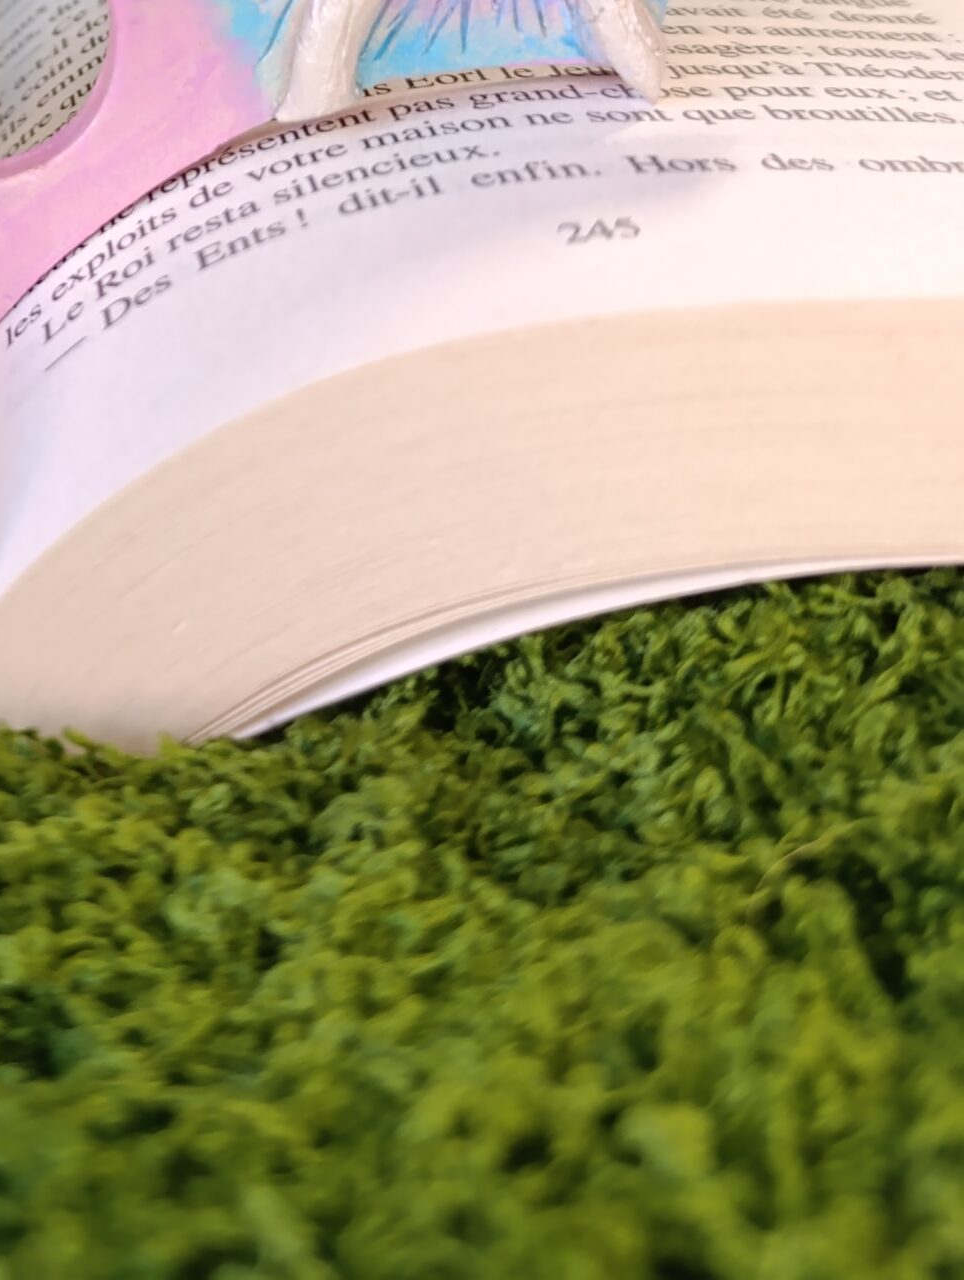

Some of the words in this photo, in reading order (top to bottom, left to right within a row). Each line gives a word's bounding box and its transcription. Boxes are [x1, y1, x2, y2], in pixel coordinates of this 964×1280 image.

[761, 6, 815, 21] été
[829, 10, 938, 25] donné
[387, 97, 455, 122] pas
[720, 86, 814, 102] pour
[923, 88, 963, 102] et
[4, 302, 43, 350] les
[50, 204, 179, 303] exploits
[188, 178, 234, 210] de
[244, 142, 349, 184] votre
[361, 113, 512, 151] maison
[525, 110, 574, 126] ne
[585, 107, 675, 124] sont
[681, 107, 757, 126] que
[40, 299, 85, 346] Le
[94, 245, 157, 321] Roi
[166, 198, 262, 256] resta
[272, 143, 502, 207] silencieux.
[100, 272, 174, 332] Des
[337, 173, 446, 218] dit-il
[469, 158, 602, 189] enfin.
[624, 153, 738, 174] Hors
[759, 152, 836, 171] des
[556, 214, 642, 247] 245
